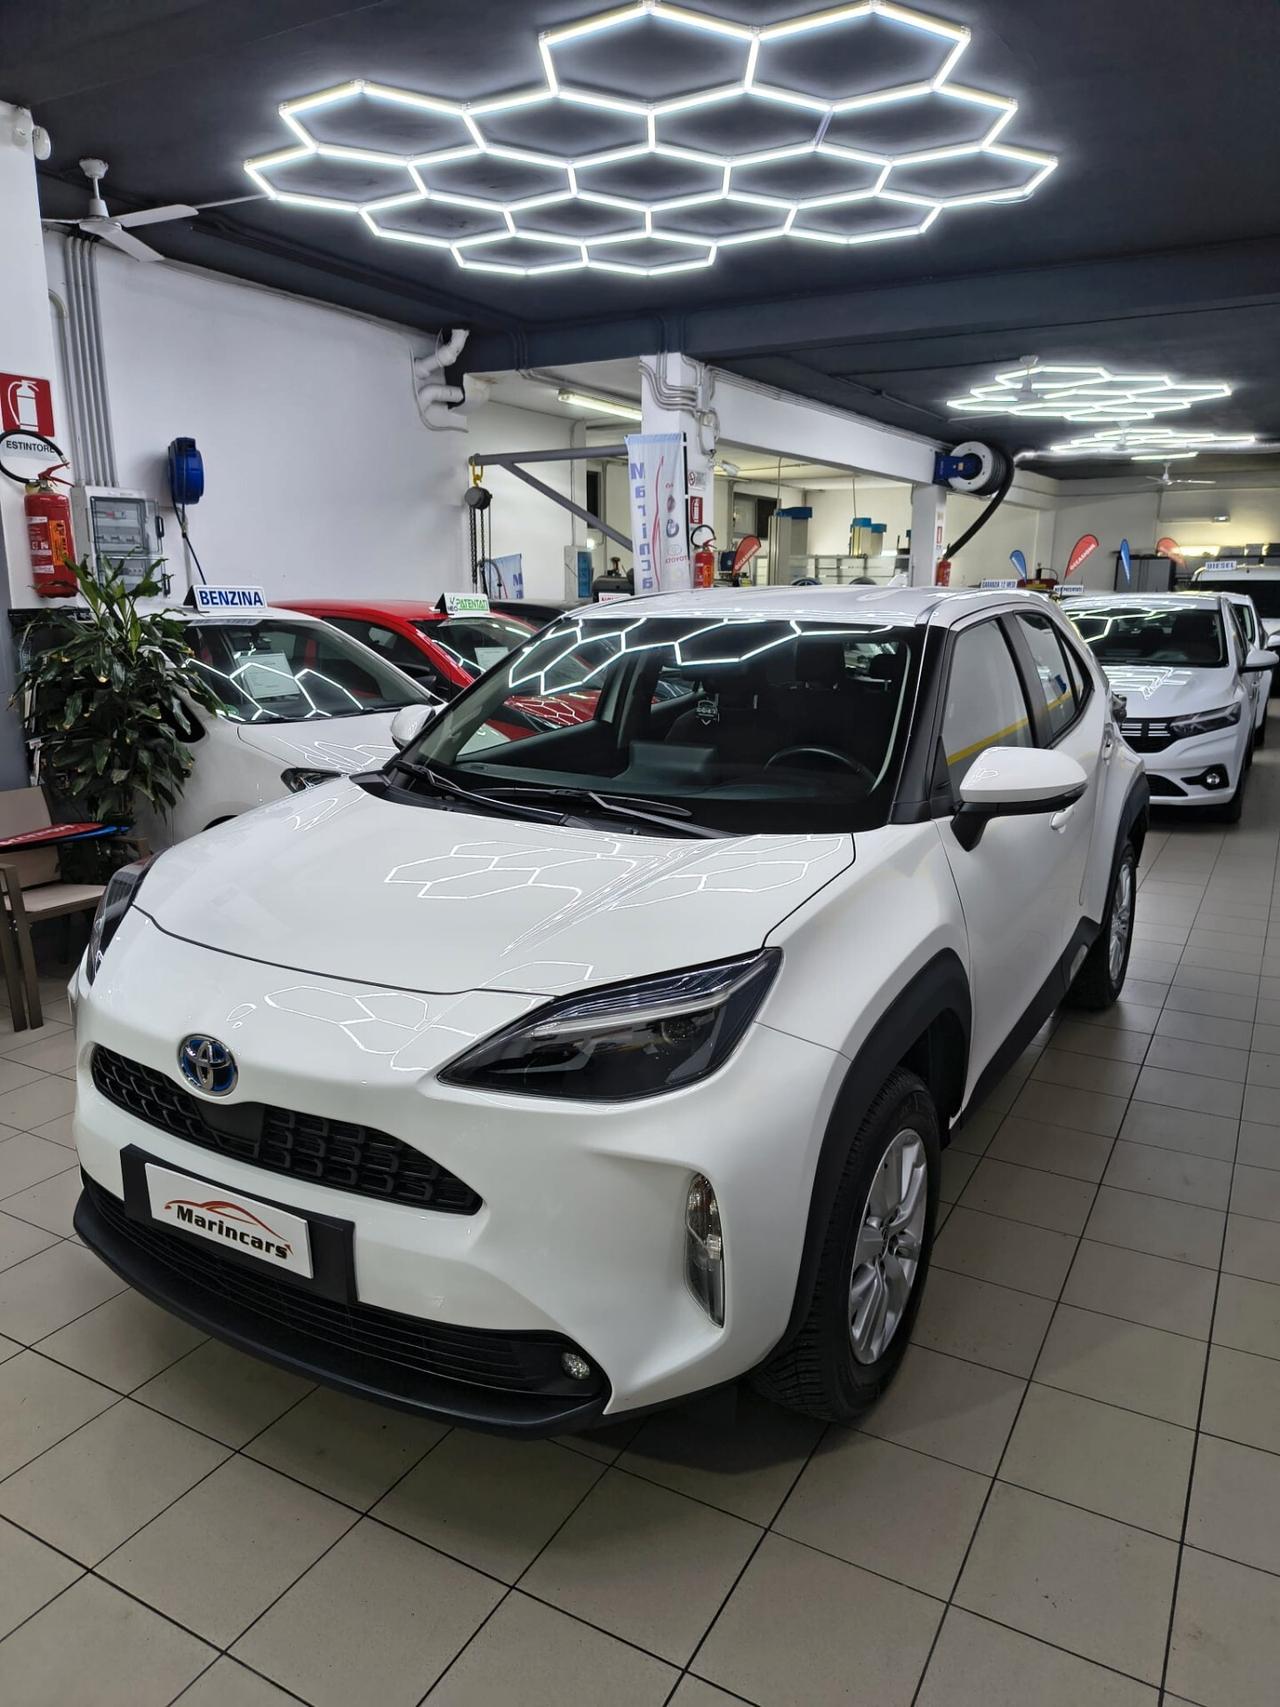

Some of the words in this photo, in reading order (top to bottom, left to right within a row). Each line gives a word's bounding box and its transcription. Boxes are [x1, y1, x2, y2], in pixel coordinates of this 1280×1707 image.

[6, 440, 55, 453] ESTINTORE
[1206, 561, 1234, 570] DIESEL
[198, 590, 263, 607] BENZINA
[176, 1204, 288, 1260] Marincars
